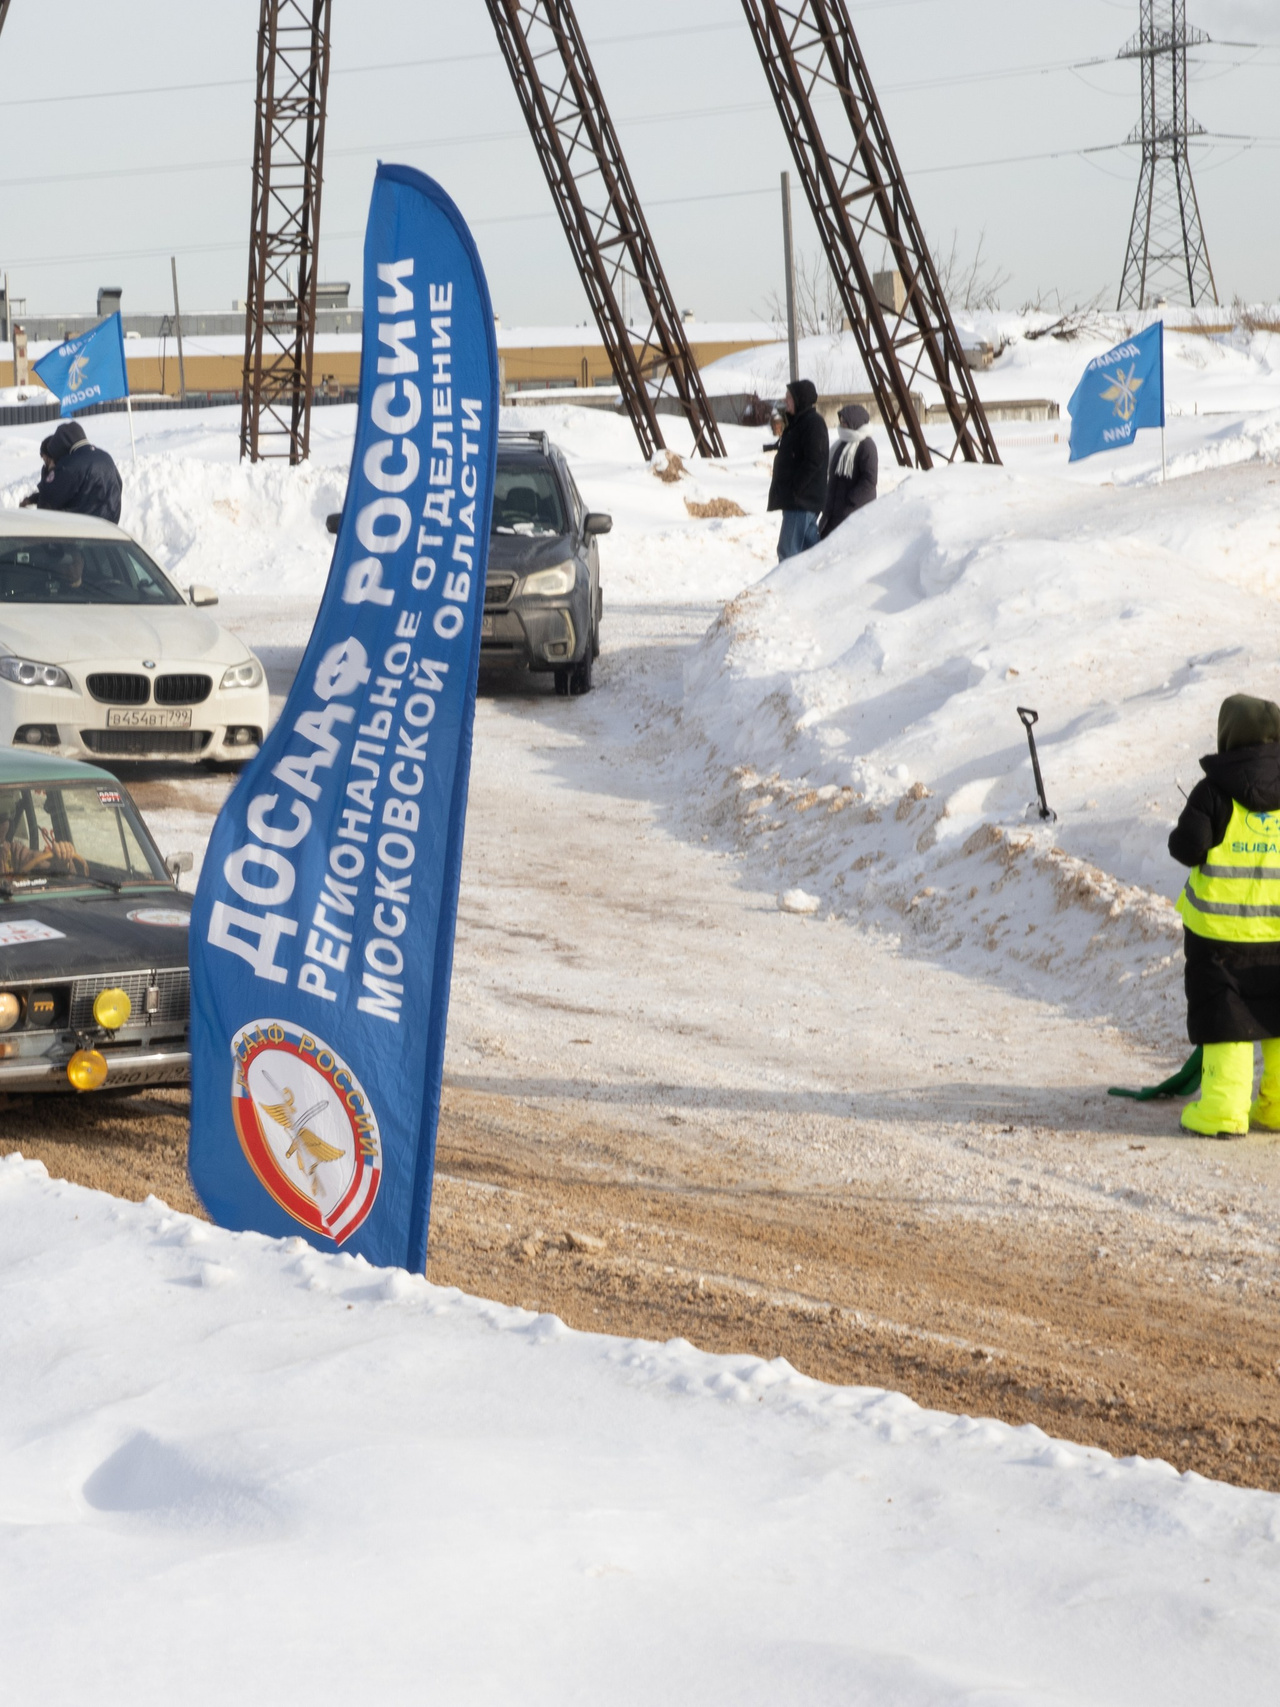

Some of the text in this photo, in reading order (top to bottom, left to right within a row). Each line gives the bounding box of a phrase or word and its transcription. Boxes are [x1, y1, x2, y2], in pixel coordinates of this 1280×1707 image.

[170, 710, 188, 722] 799
[207, 257, 422, 985] ДОСААФ РОССИИ
[297, 282, 453, 1001] РЕГИОНАЛЬНОЕ ОТДЕЛЕНИЕ
[357, 398, 482, 1023] МОСКОВСКОЙ ОБЛАСТИ
[1232, 842, 1280, 853] SUBA
[298, 1033, 378, 1156] РОССИИ
